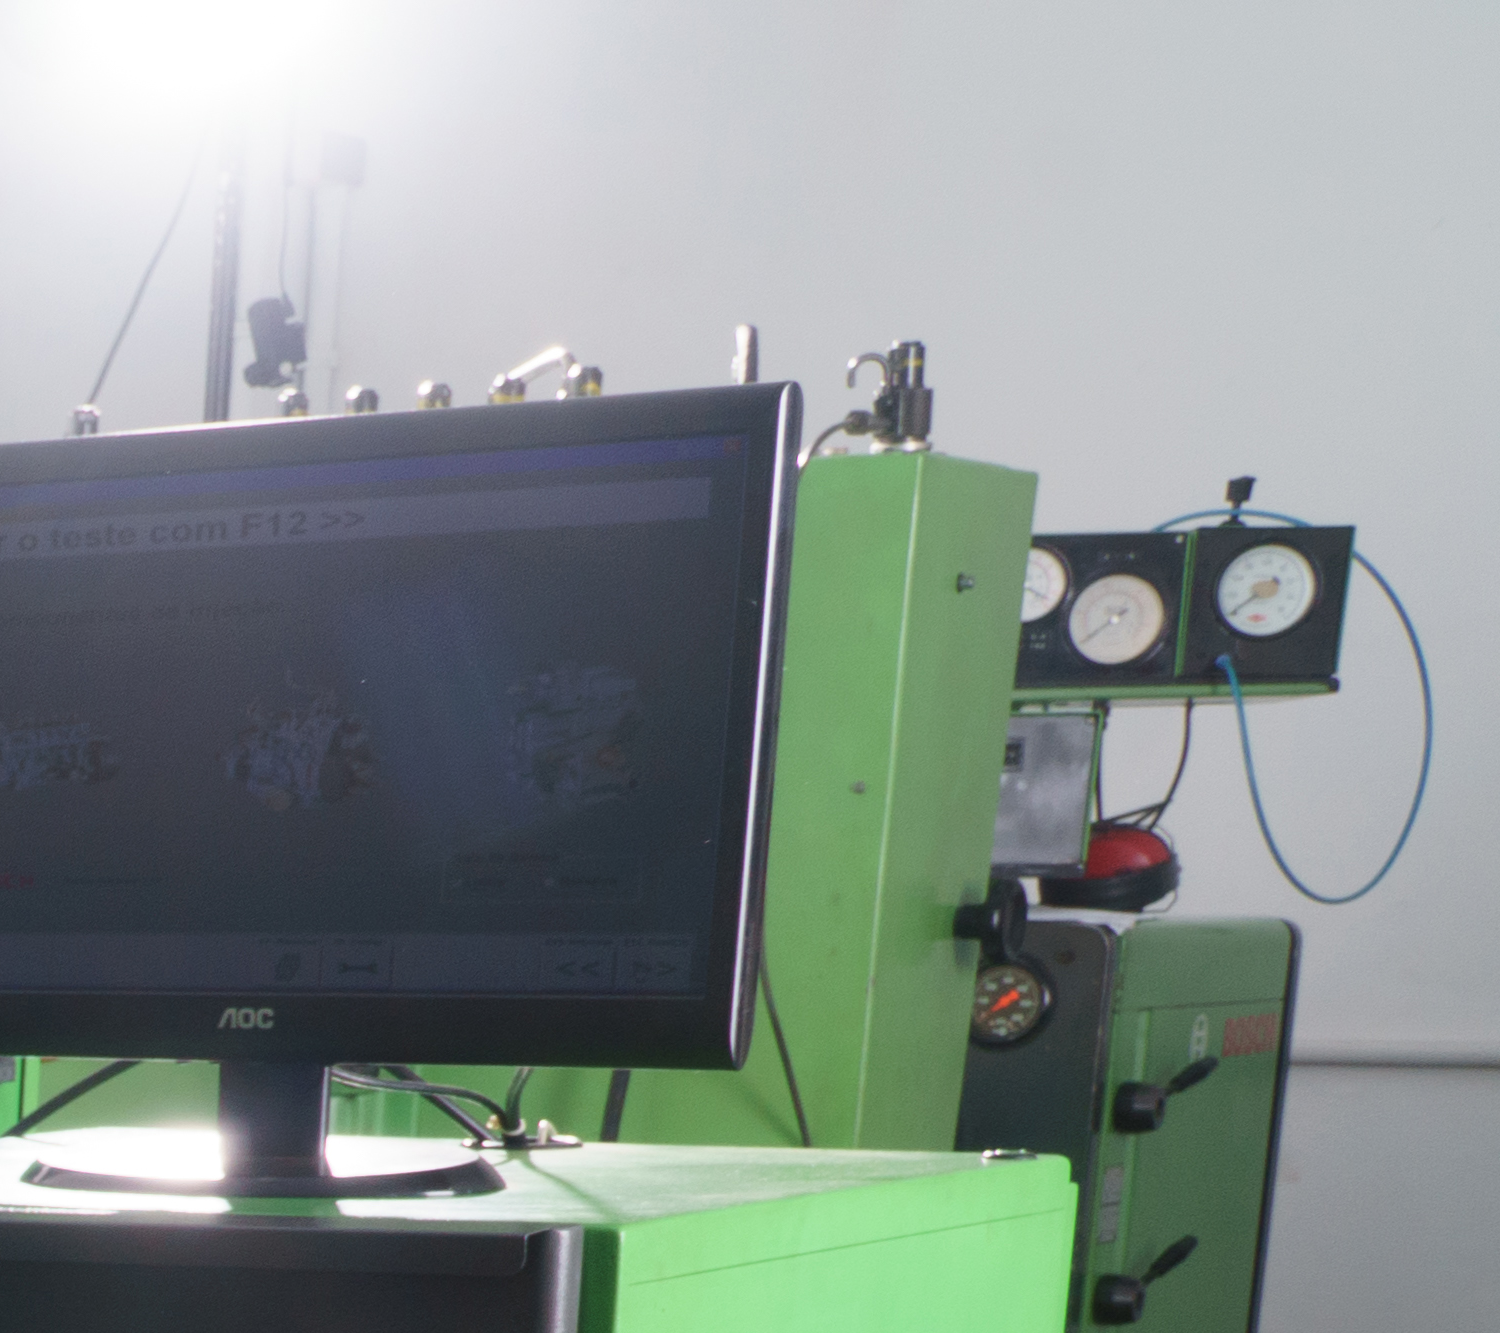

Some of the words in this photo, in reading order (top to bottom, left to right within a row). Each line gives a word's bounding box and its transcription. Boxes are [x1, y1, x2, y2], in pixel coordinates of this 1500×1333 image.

[52, 522, 137, 549] teste
[150, 517, 227, 544] com
[239, 511, 306, 539] F12
[218, 1007, 275, 1029] AOC
